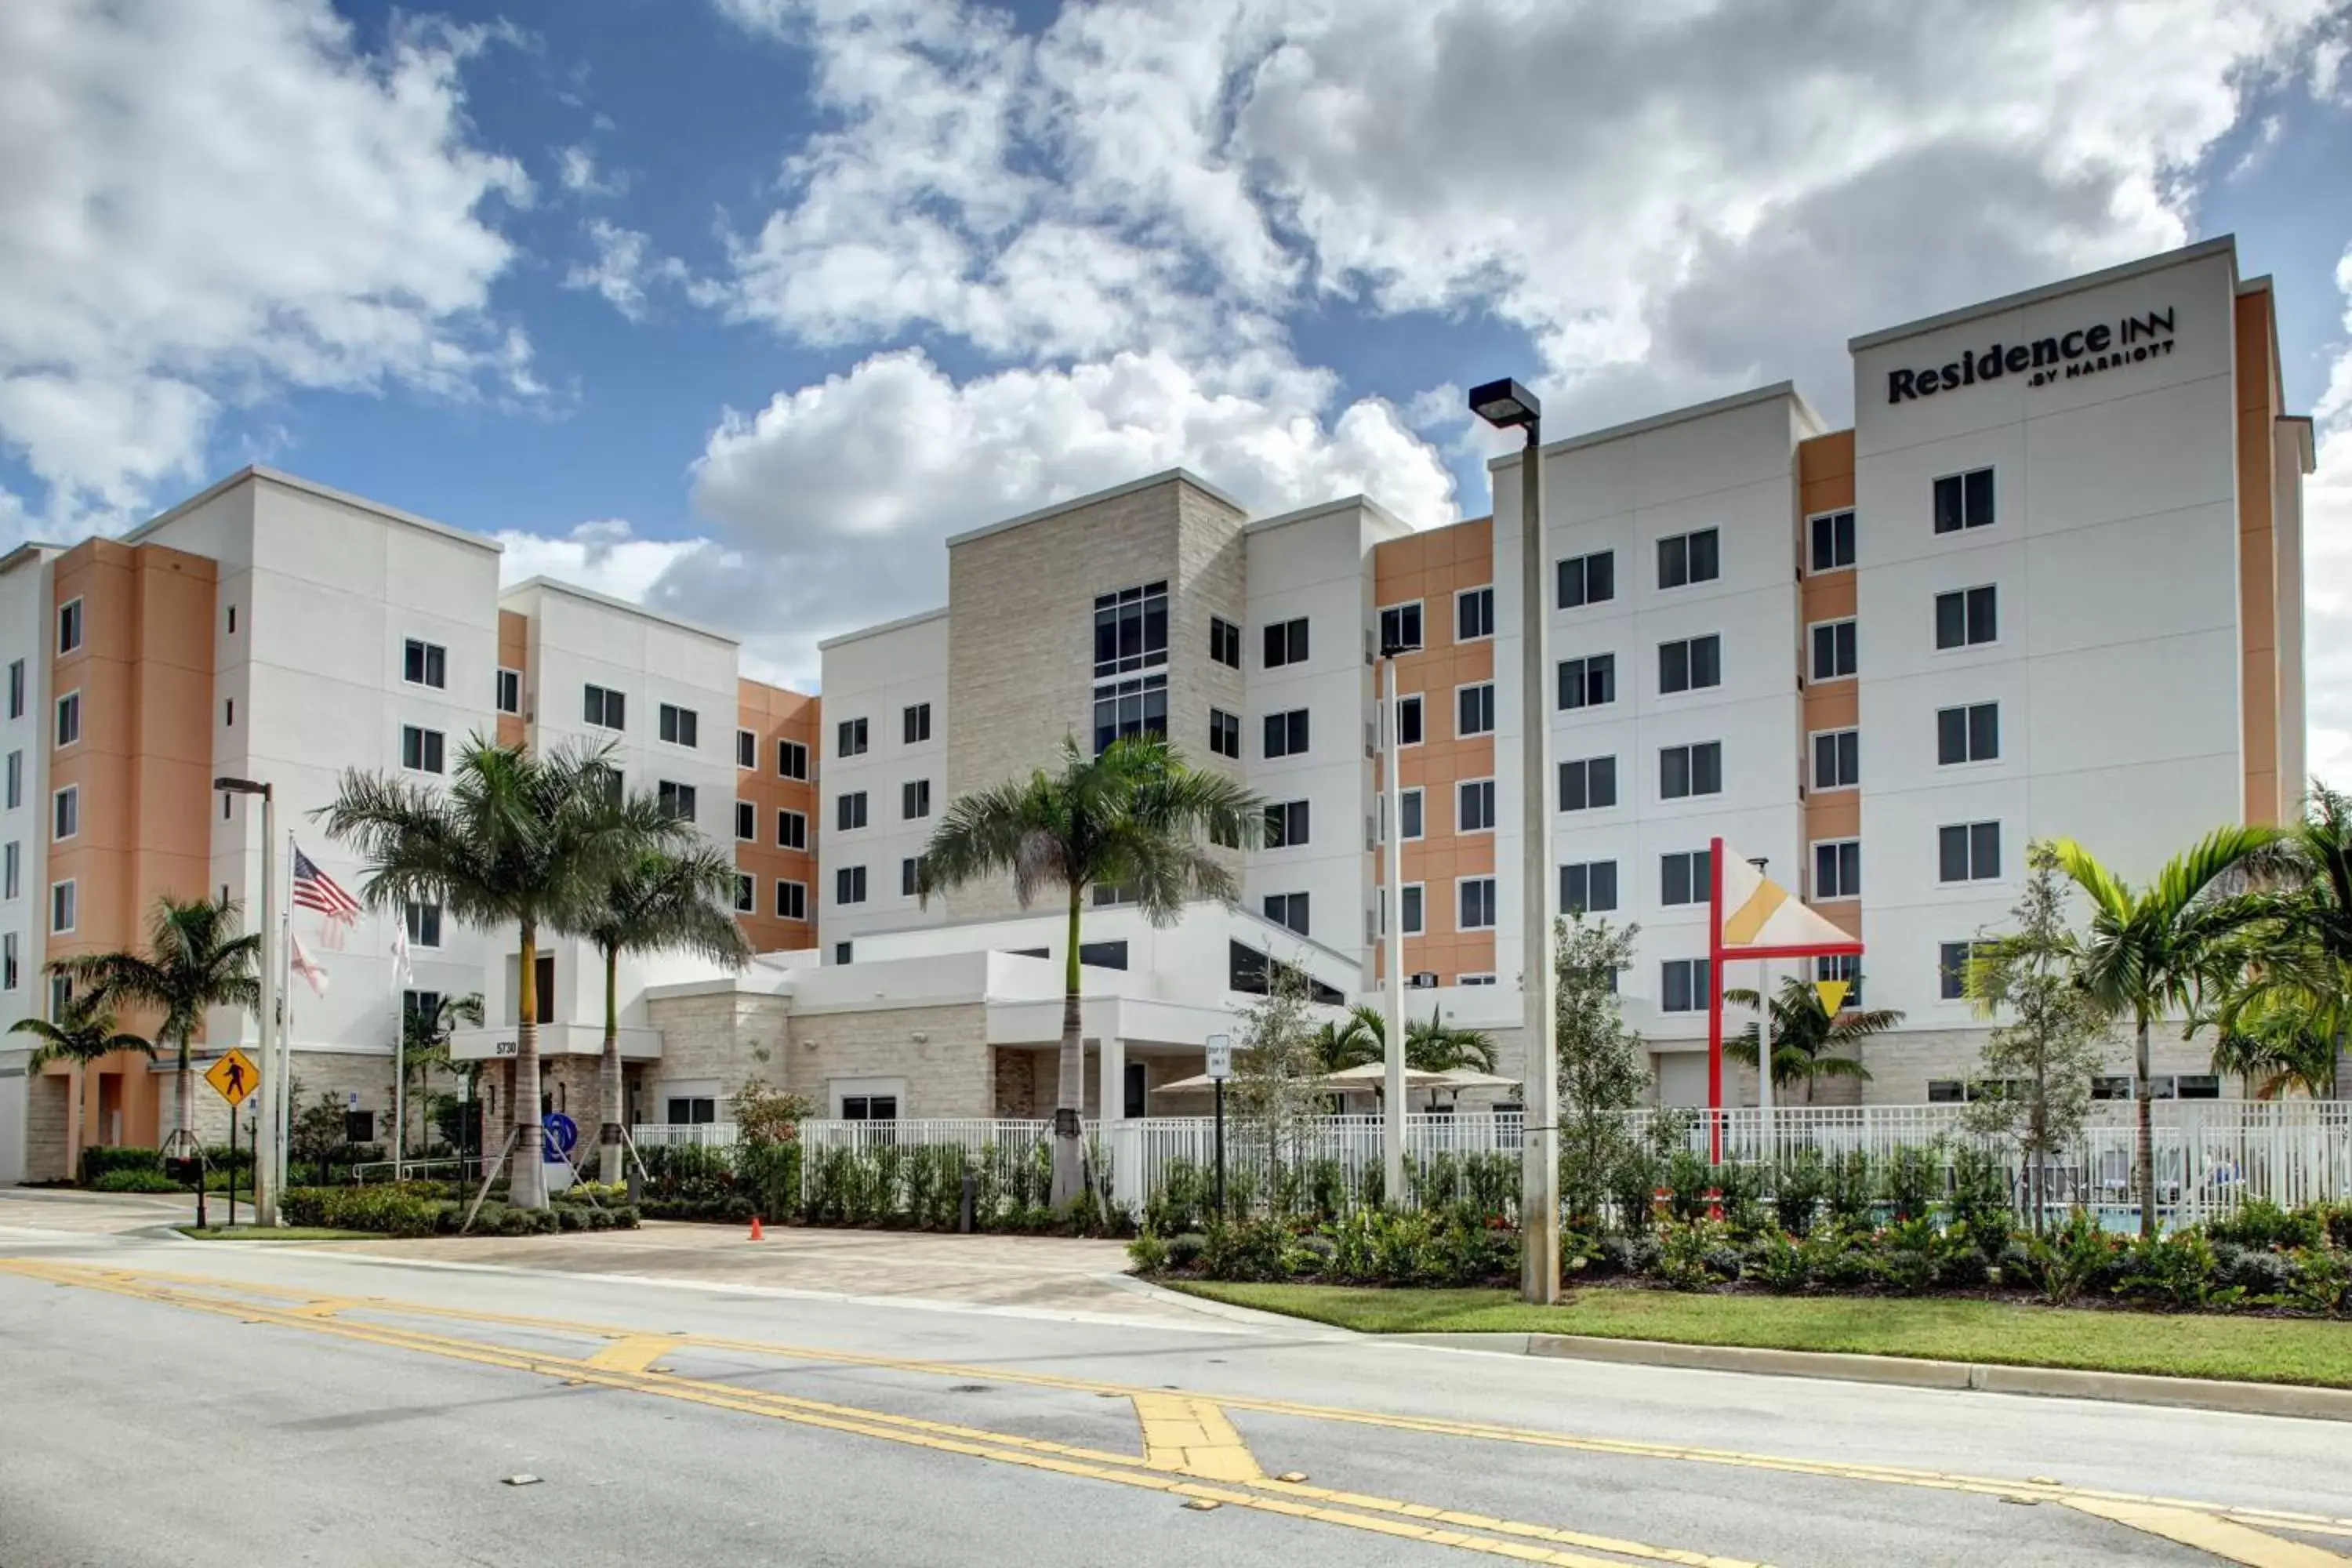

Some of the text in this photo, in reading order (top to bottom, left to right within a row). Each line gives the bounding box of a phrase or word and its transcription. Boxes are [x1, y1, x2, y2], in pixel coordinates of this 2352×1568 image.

[1888, 306, 2175, 405] Residence INN
[2066, 339, 2174, 379] MARRIOTT
